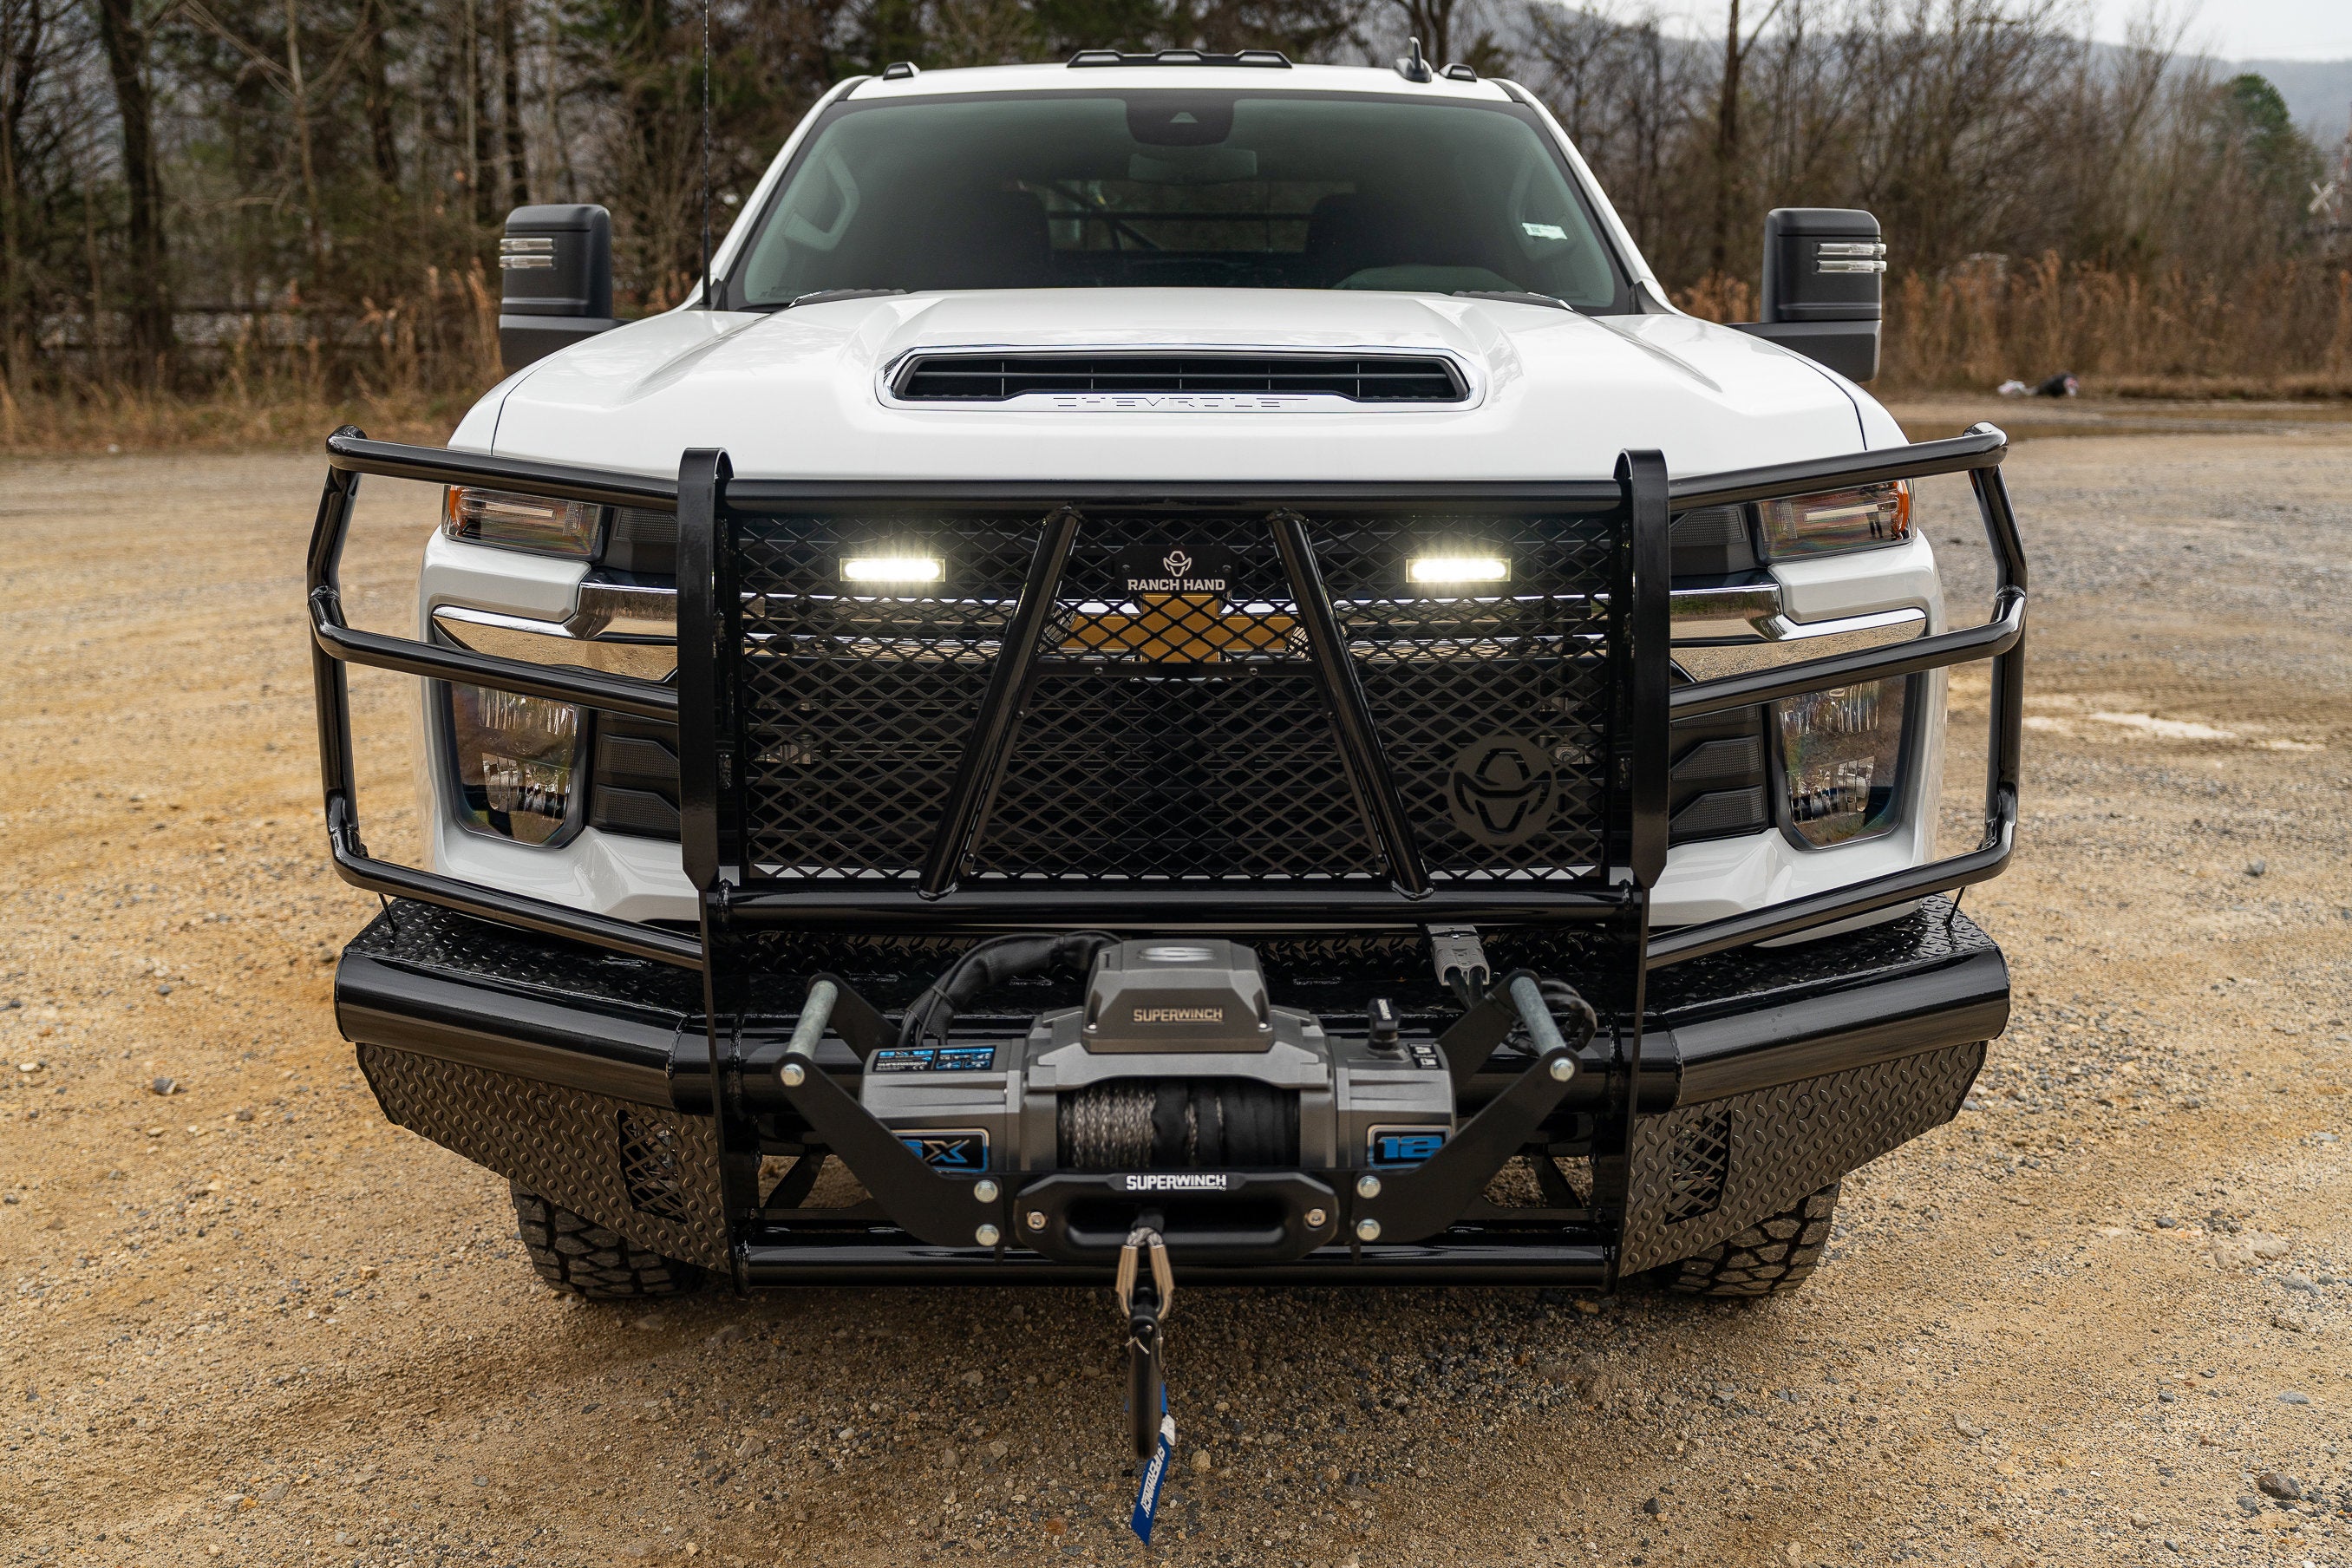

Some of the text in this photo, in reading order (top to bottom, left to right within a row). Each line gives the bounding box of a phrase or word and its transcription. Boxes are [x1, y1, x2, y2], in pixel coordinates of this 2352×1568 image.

[1053, 396, 1308, 408] CHEVROLET
[1127, 578, 1225, 591] RANCH HAND
[1133, 1008, 1224, 1022] SUPERWINCH
[1376, 1135, 1443, 1160] 12
[1126, 1173, 1228, 1191] SUPERWINCH
